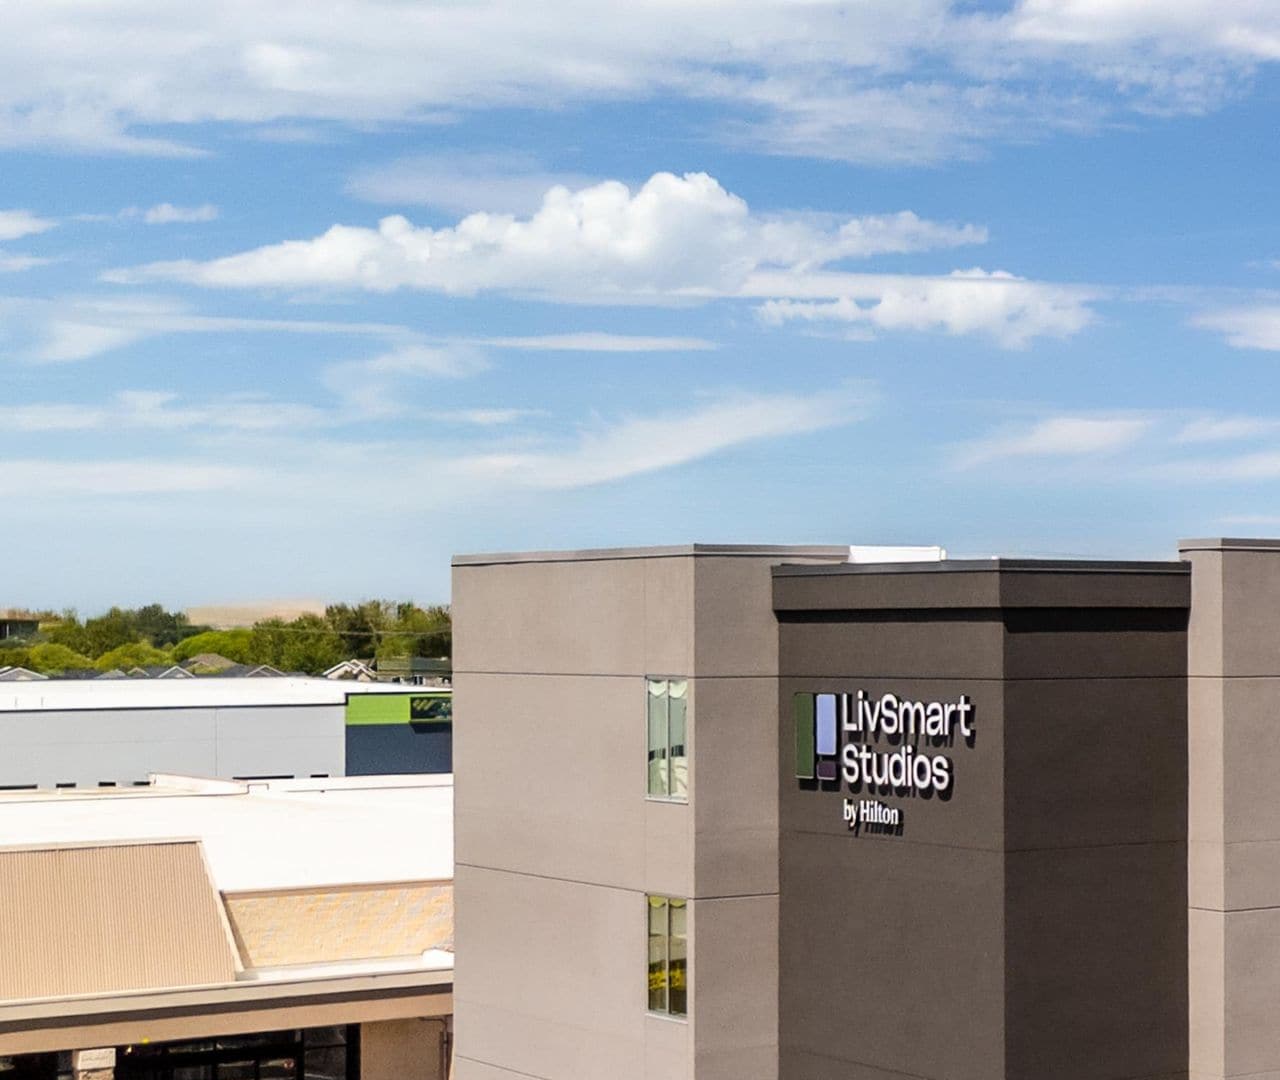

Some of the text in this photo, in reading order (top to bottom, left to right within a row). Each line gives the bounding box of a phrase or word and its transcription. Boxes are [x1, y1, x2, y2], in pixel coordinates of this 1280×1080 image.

[842, 690, 971, 736] LivSmart
[842, 744, 949, 790] Studios
[843, 799, 899, 826] by Hilton
